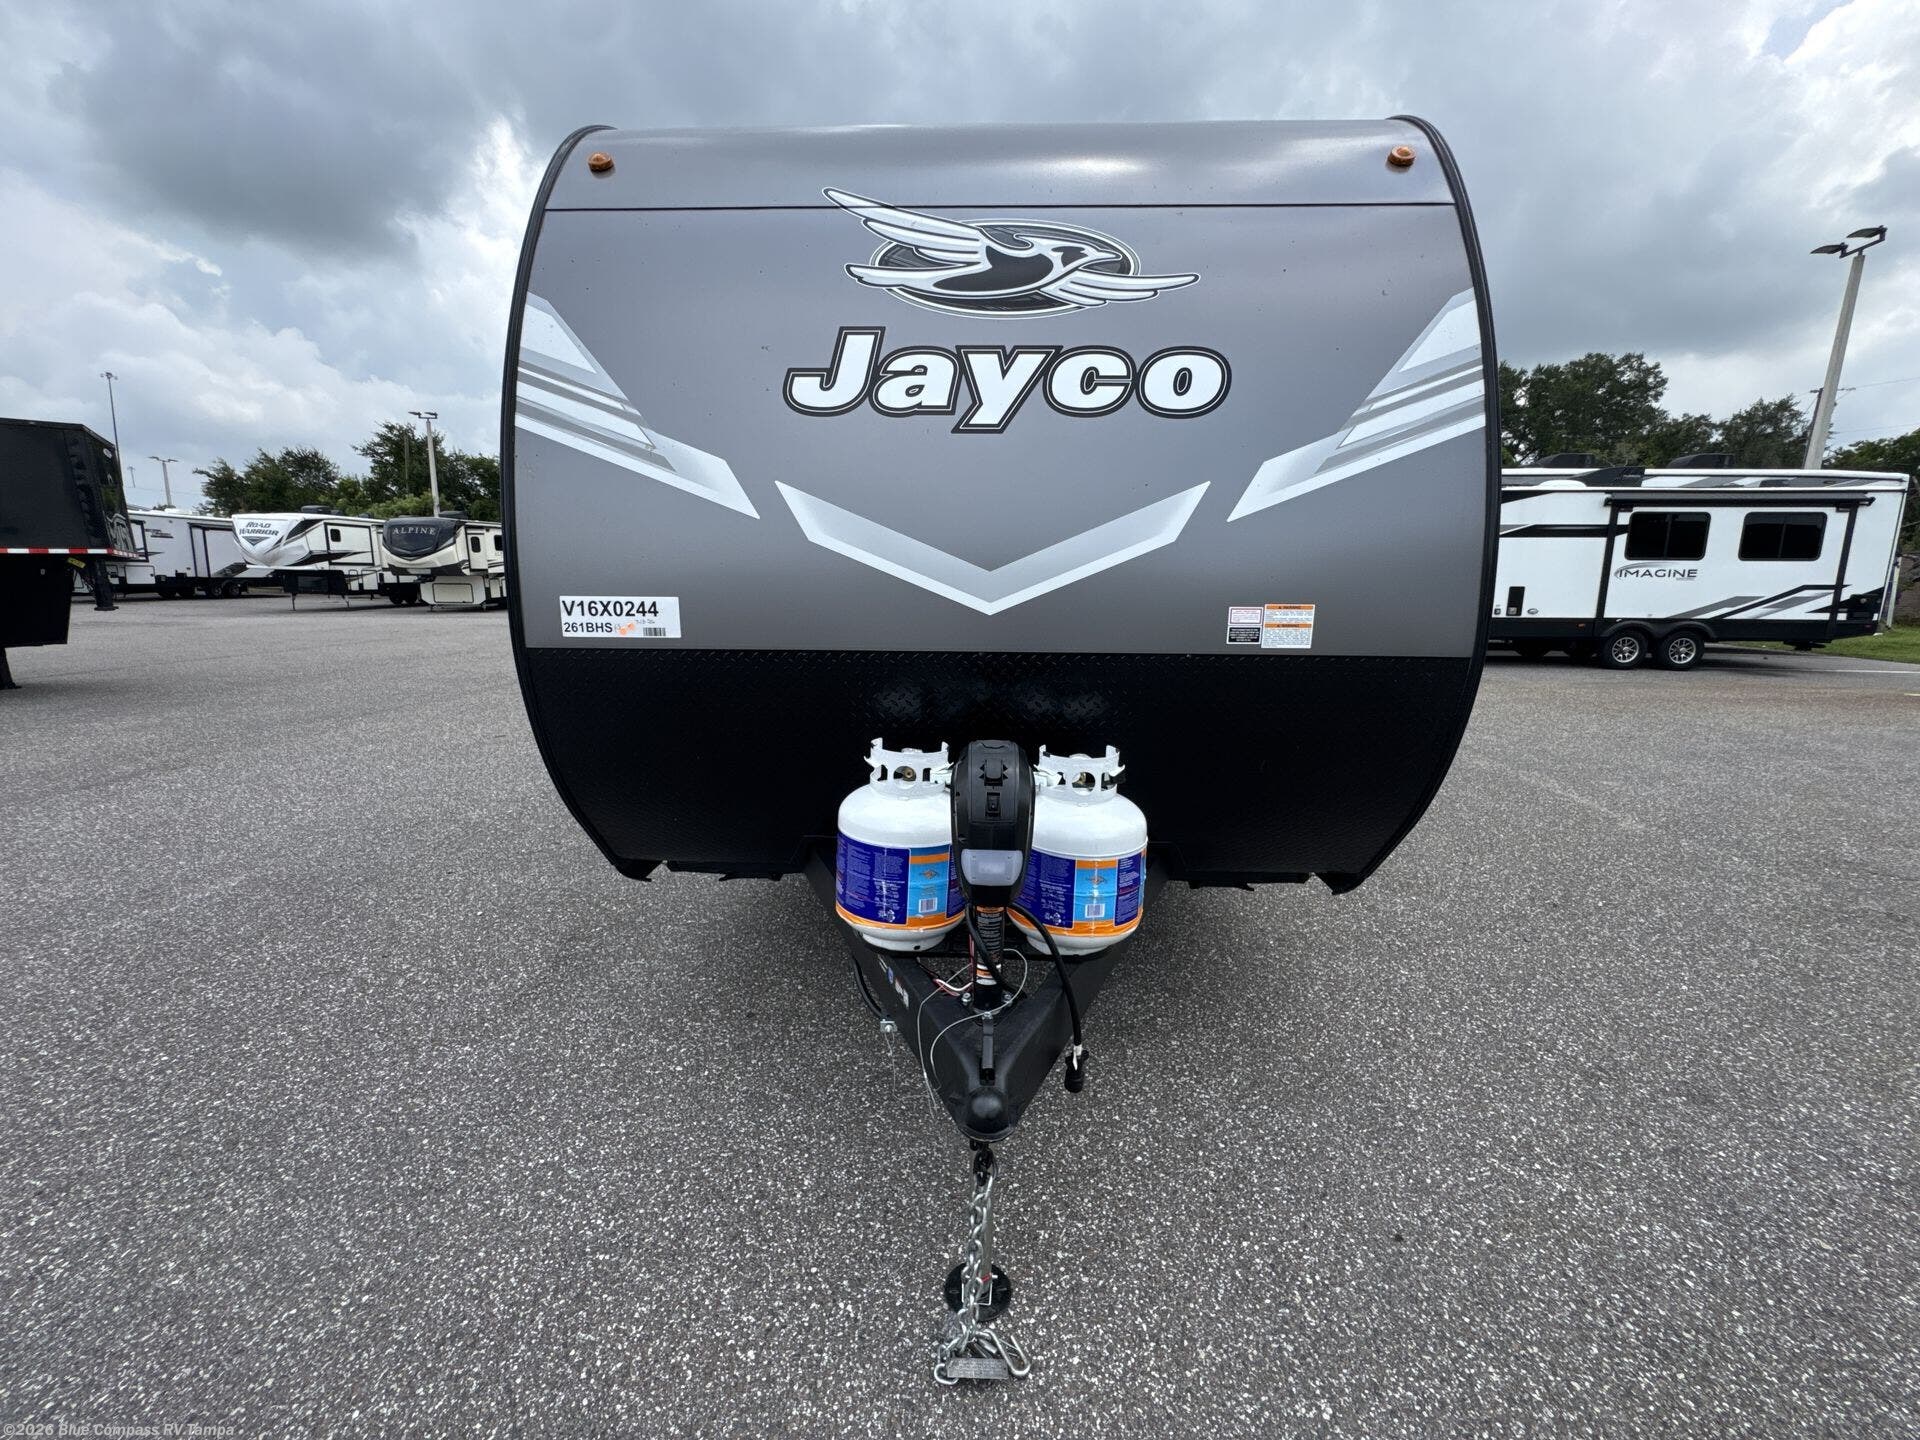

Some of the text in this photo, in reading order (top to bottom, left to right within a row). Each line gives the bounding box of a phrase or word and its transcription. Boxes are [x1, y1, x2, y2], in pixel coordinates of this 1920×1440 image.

[783, 326, 1232, 434] Jayco
[392, 526, 436, 535] ALPINE
[1619, 568, 1697, 578] IMAGINE
[562, 600, 659, 617] V16X0244
[563, 622, 613, 633] 261BHS
